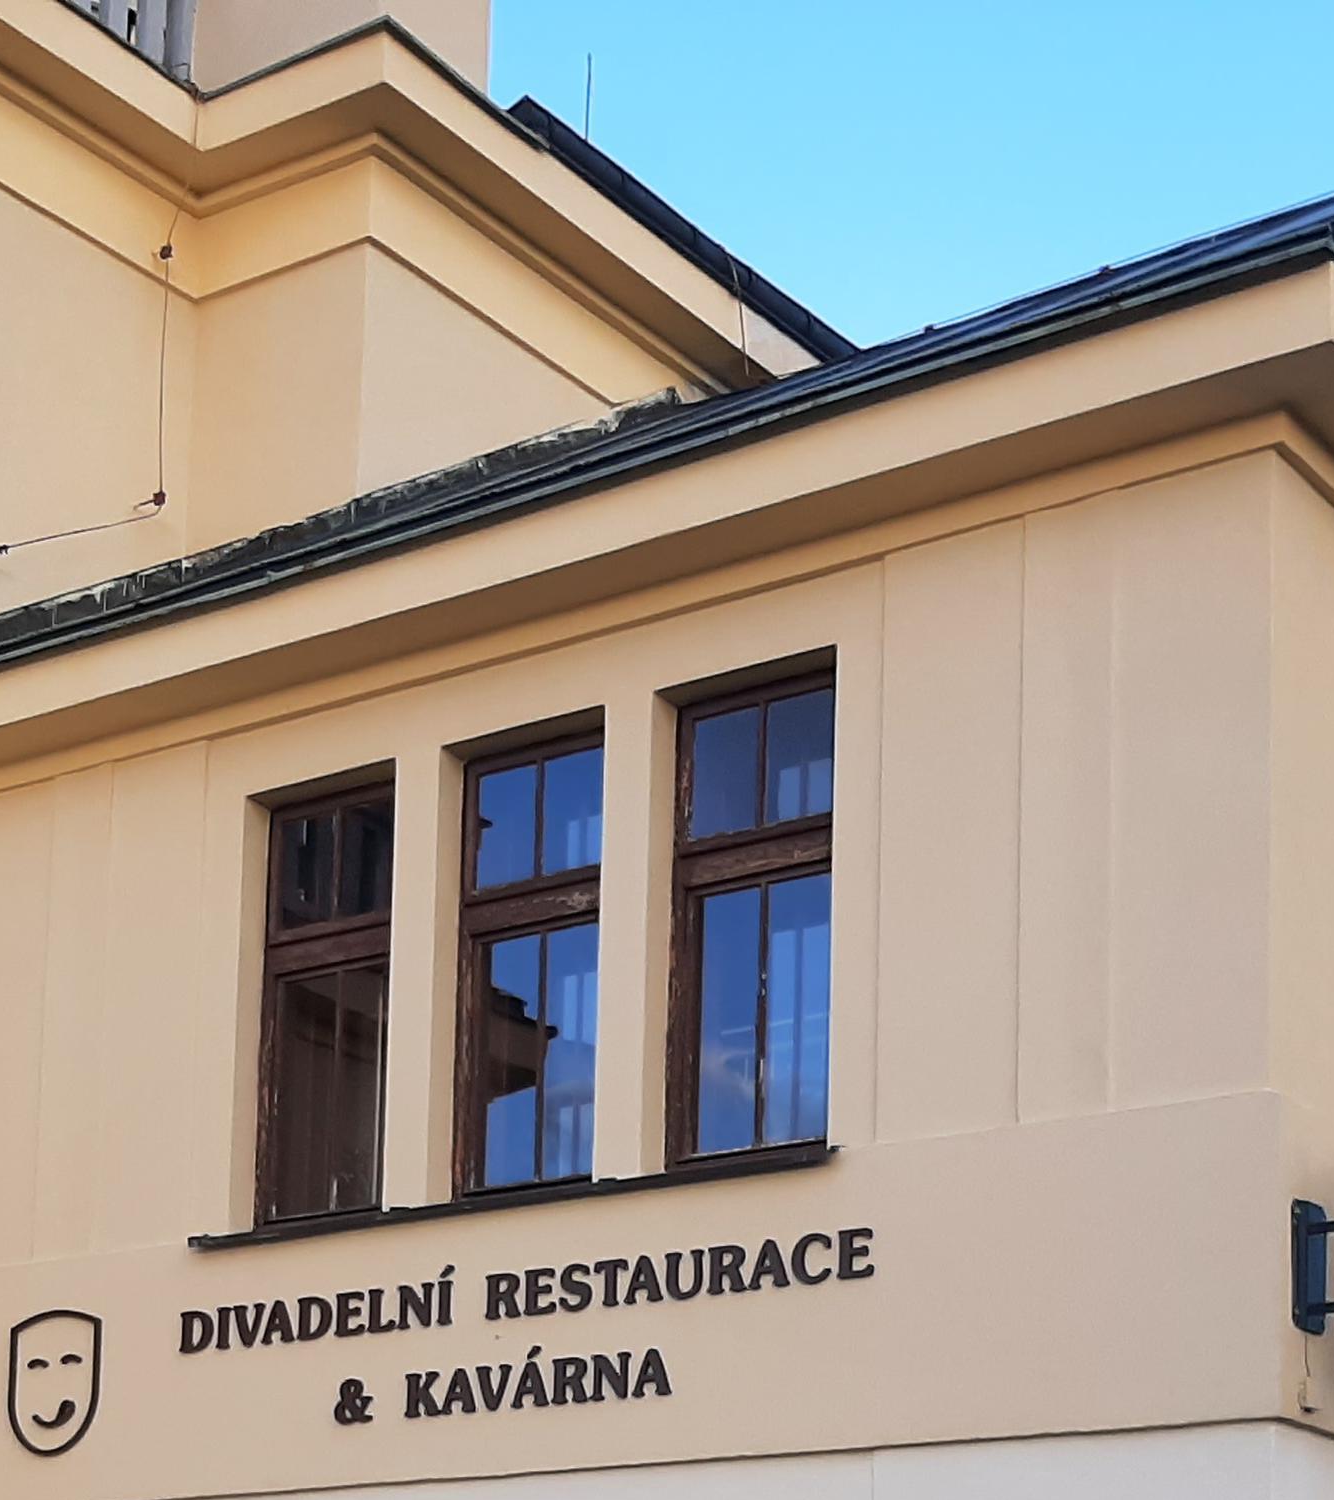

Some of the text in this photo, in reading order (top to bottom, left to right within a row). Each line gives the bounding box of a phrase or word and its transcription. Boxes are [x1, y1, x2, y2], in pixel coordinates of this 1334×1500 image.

[178, 1227, 875, 1354] DIVADELNÍ RESTAURACE
[333, 1345, 673, 1426] & KAVÁRNA
